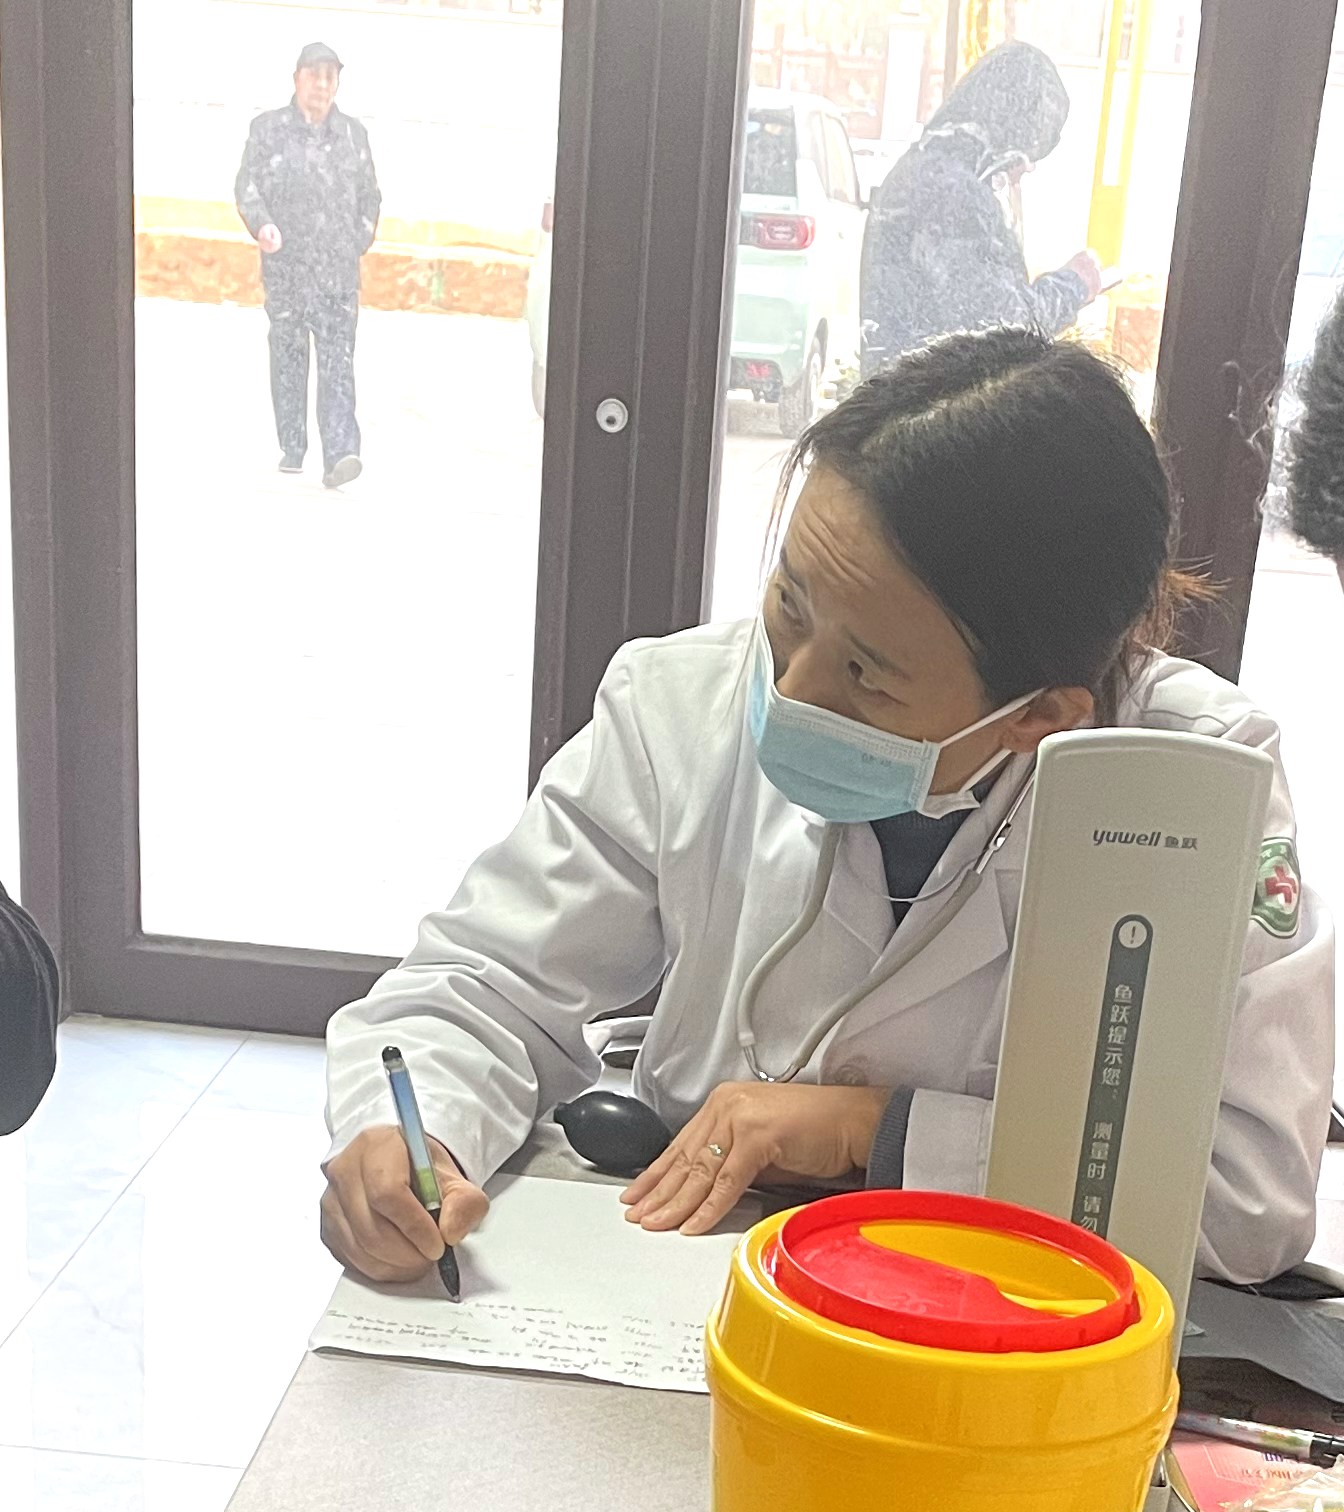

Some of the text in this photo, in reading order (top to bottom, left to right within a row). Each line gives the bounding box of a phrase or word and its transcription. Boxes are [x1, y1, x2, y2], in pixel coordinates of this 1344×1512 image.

[1093, 829, 1198, 851] yuwell 鱼跃
[1081, 1121, 1114, 1234] 测量时 请勿
